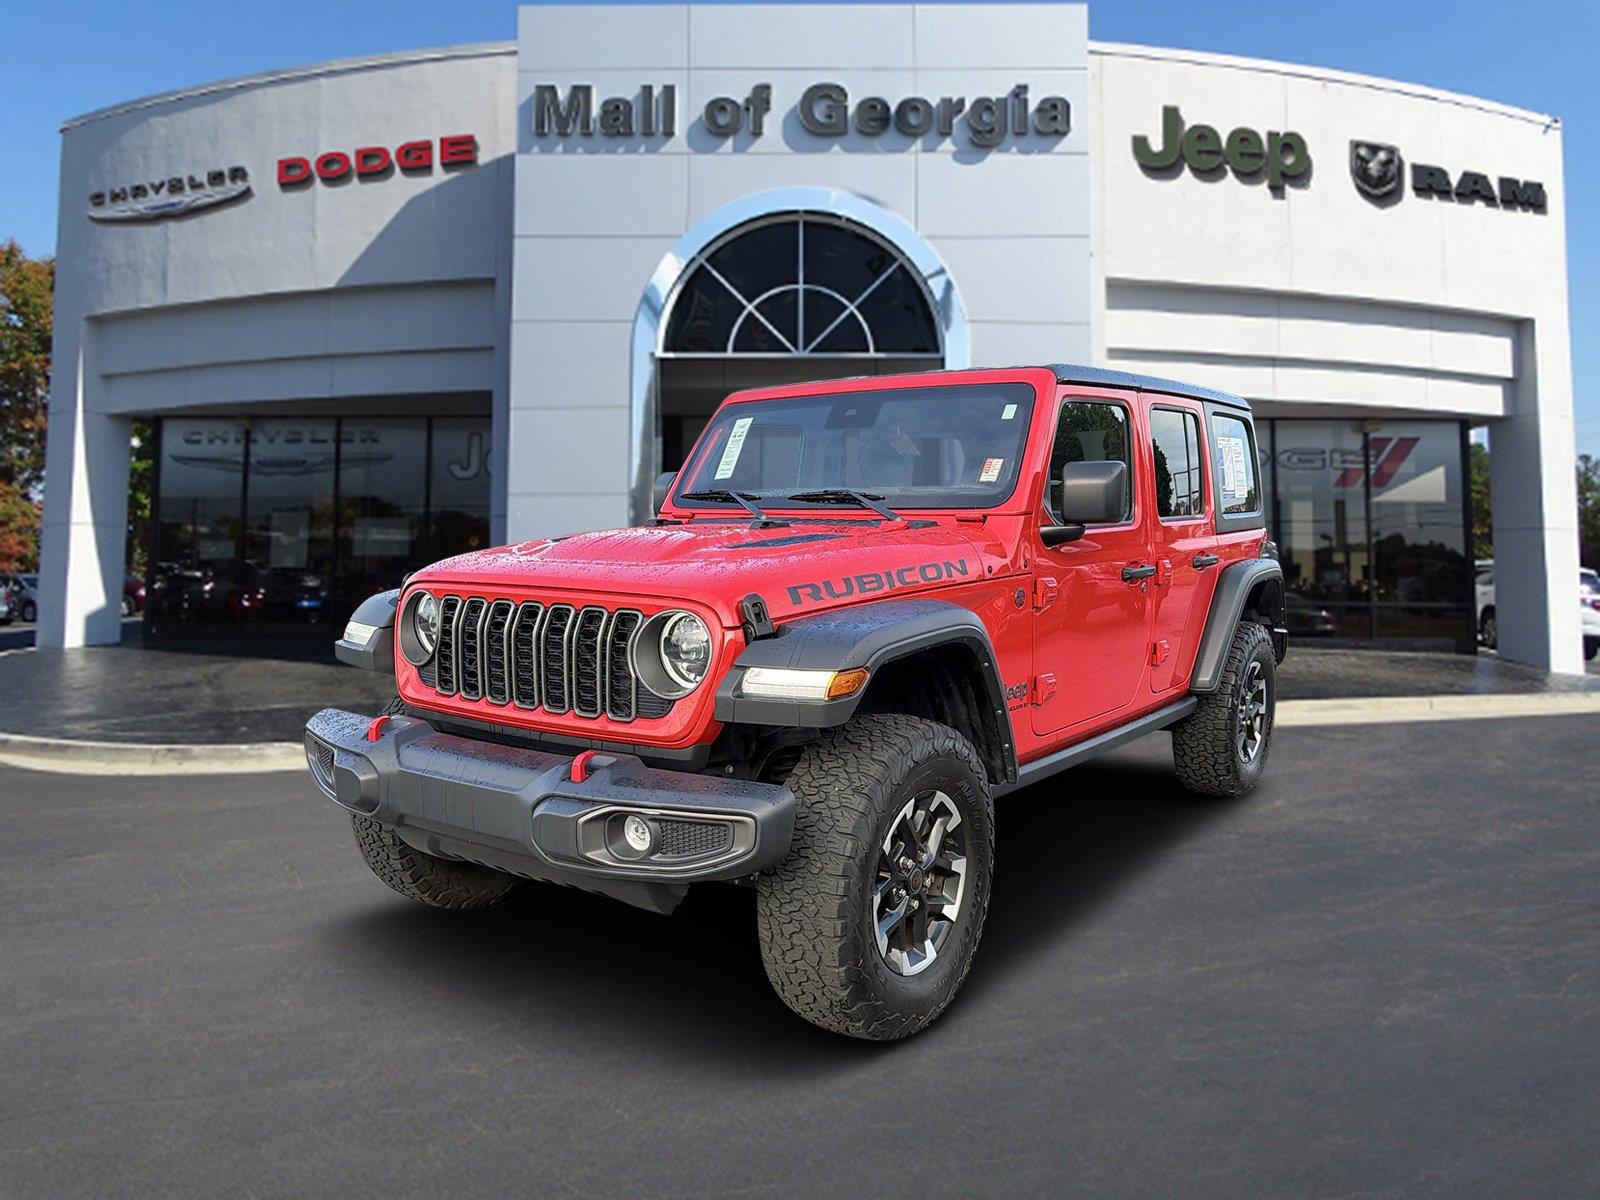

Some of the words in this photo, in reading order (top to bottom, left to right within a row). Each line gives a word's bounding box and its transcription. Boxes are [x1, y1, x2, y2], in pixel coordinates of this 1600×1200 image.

[533, 84, 677, 137] Mall
[704, 84, 772, 137] of
[799, 83, 1072, 148] Georgia
[277, 134, 478, 187] DODGE
[1131, 104, 1310, 194] Jeep
[89, 166, 249, 207] CHRYSLER
[1411, 162, 1548, 215] RAM
[786, 559, 969, 605] RUBICON
